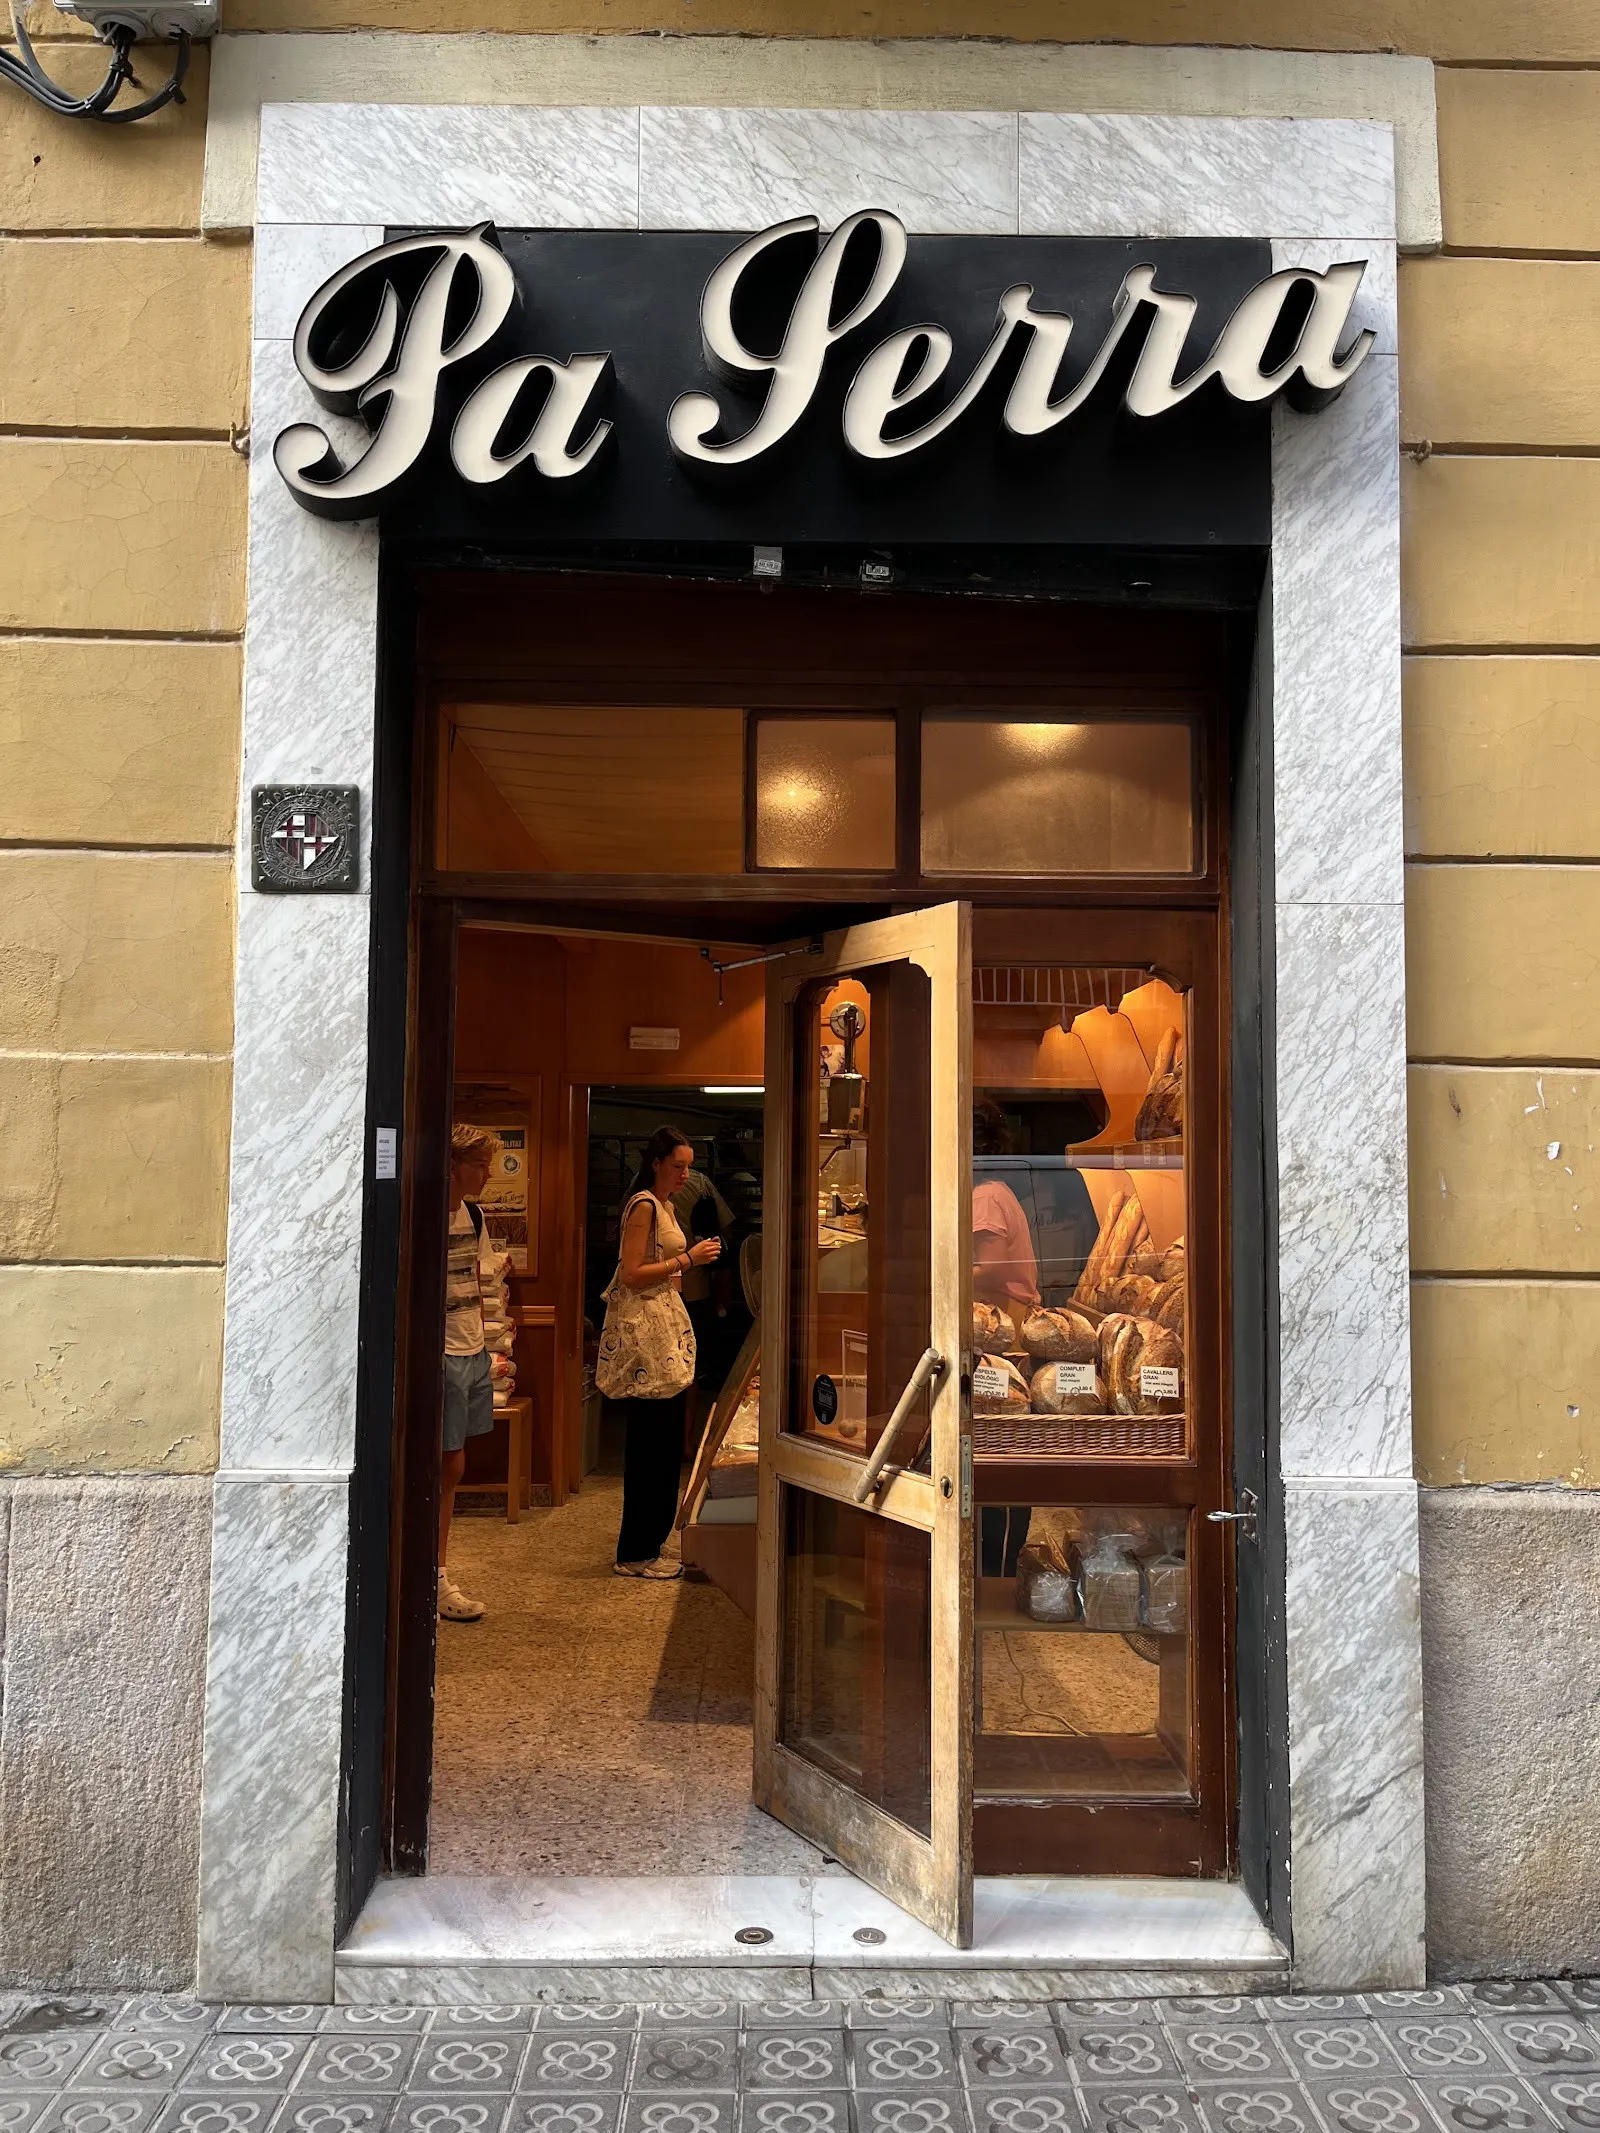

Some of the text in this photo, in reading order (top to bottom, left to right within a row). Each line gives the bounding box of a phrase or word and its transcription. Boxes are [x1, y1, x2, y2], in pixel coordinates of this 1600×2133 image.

[273, 207, 1377, 512] Pa Serra
[273, 786, 292, 802] DE
